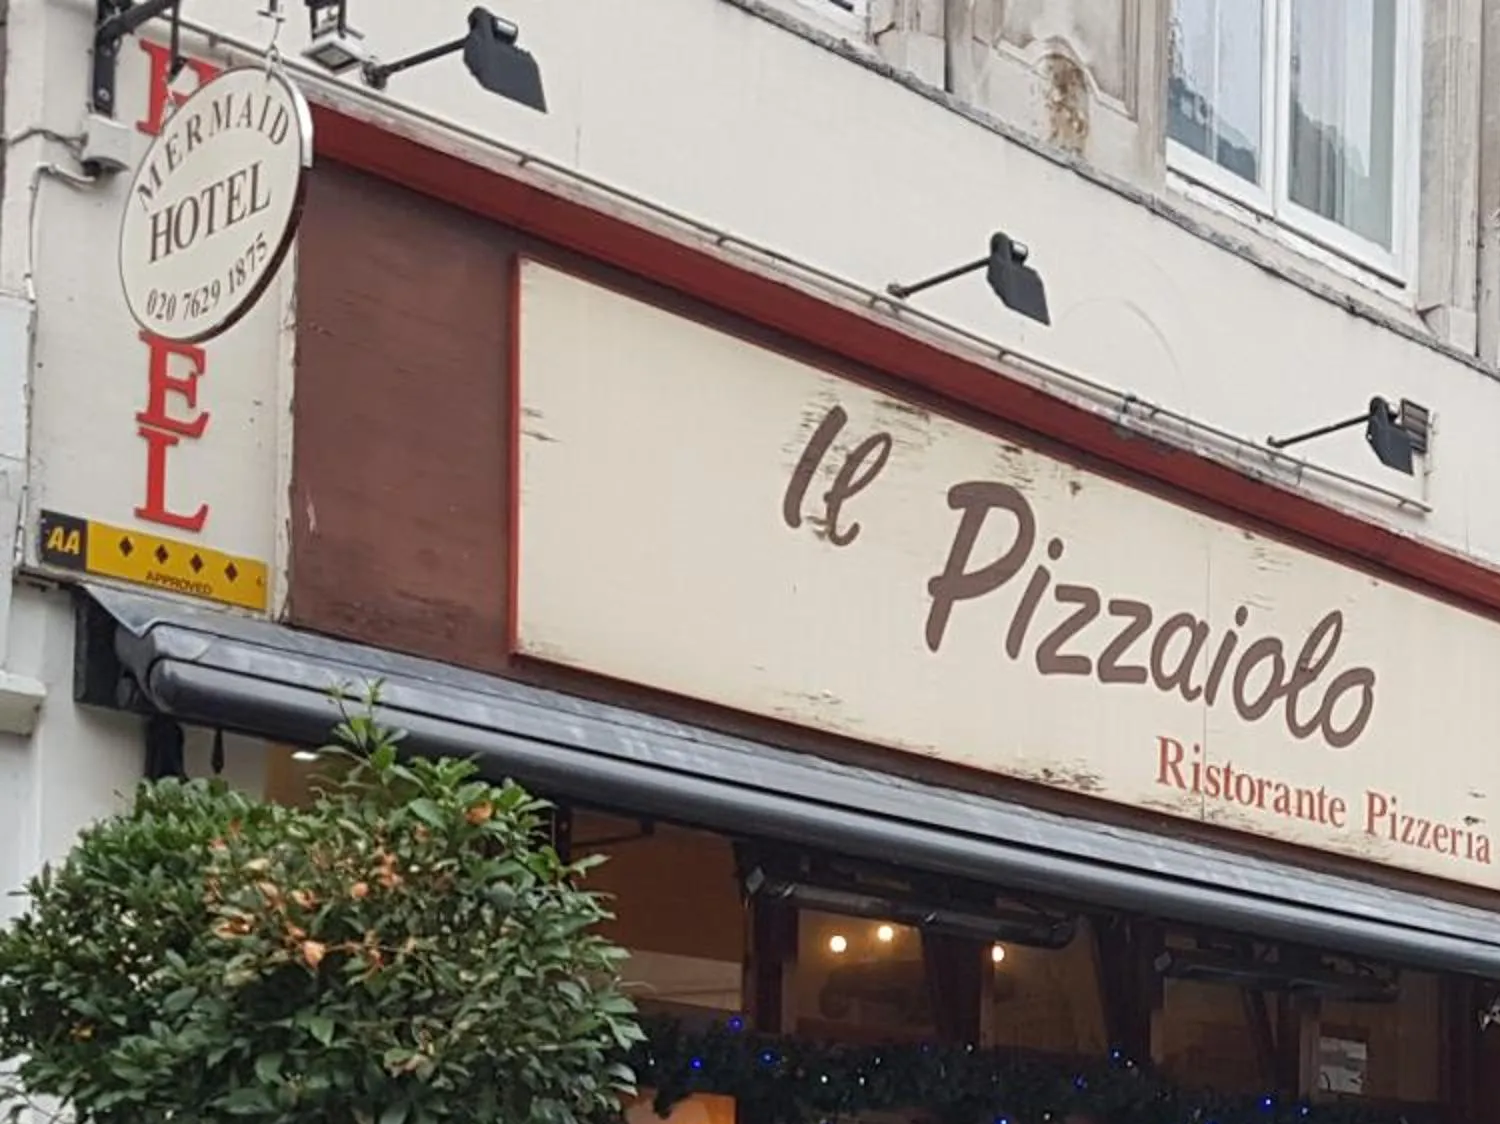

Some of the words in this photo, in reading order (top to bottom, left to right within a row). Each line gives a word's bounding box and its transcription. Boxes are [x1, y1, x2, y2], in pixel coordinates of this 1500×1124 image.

[136, 92, 290, 212] MERMAID
[148, 160, 271, 264] HOTEL
[146, 287, 177, 321] 020
[181, 280, 221, 321] 7629
[227, 232, 268, 295] 1875
[47, 526, 81, 556] AA
[145, 570, 213, 595] APPROVED
[925, 480, 1376, 749] Pizzaiolo
[1155, 735, 1347, 829] Ristorante
[1365, 789, 1492, 865] Pizzeria
